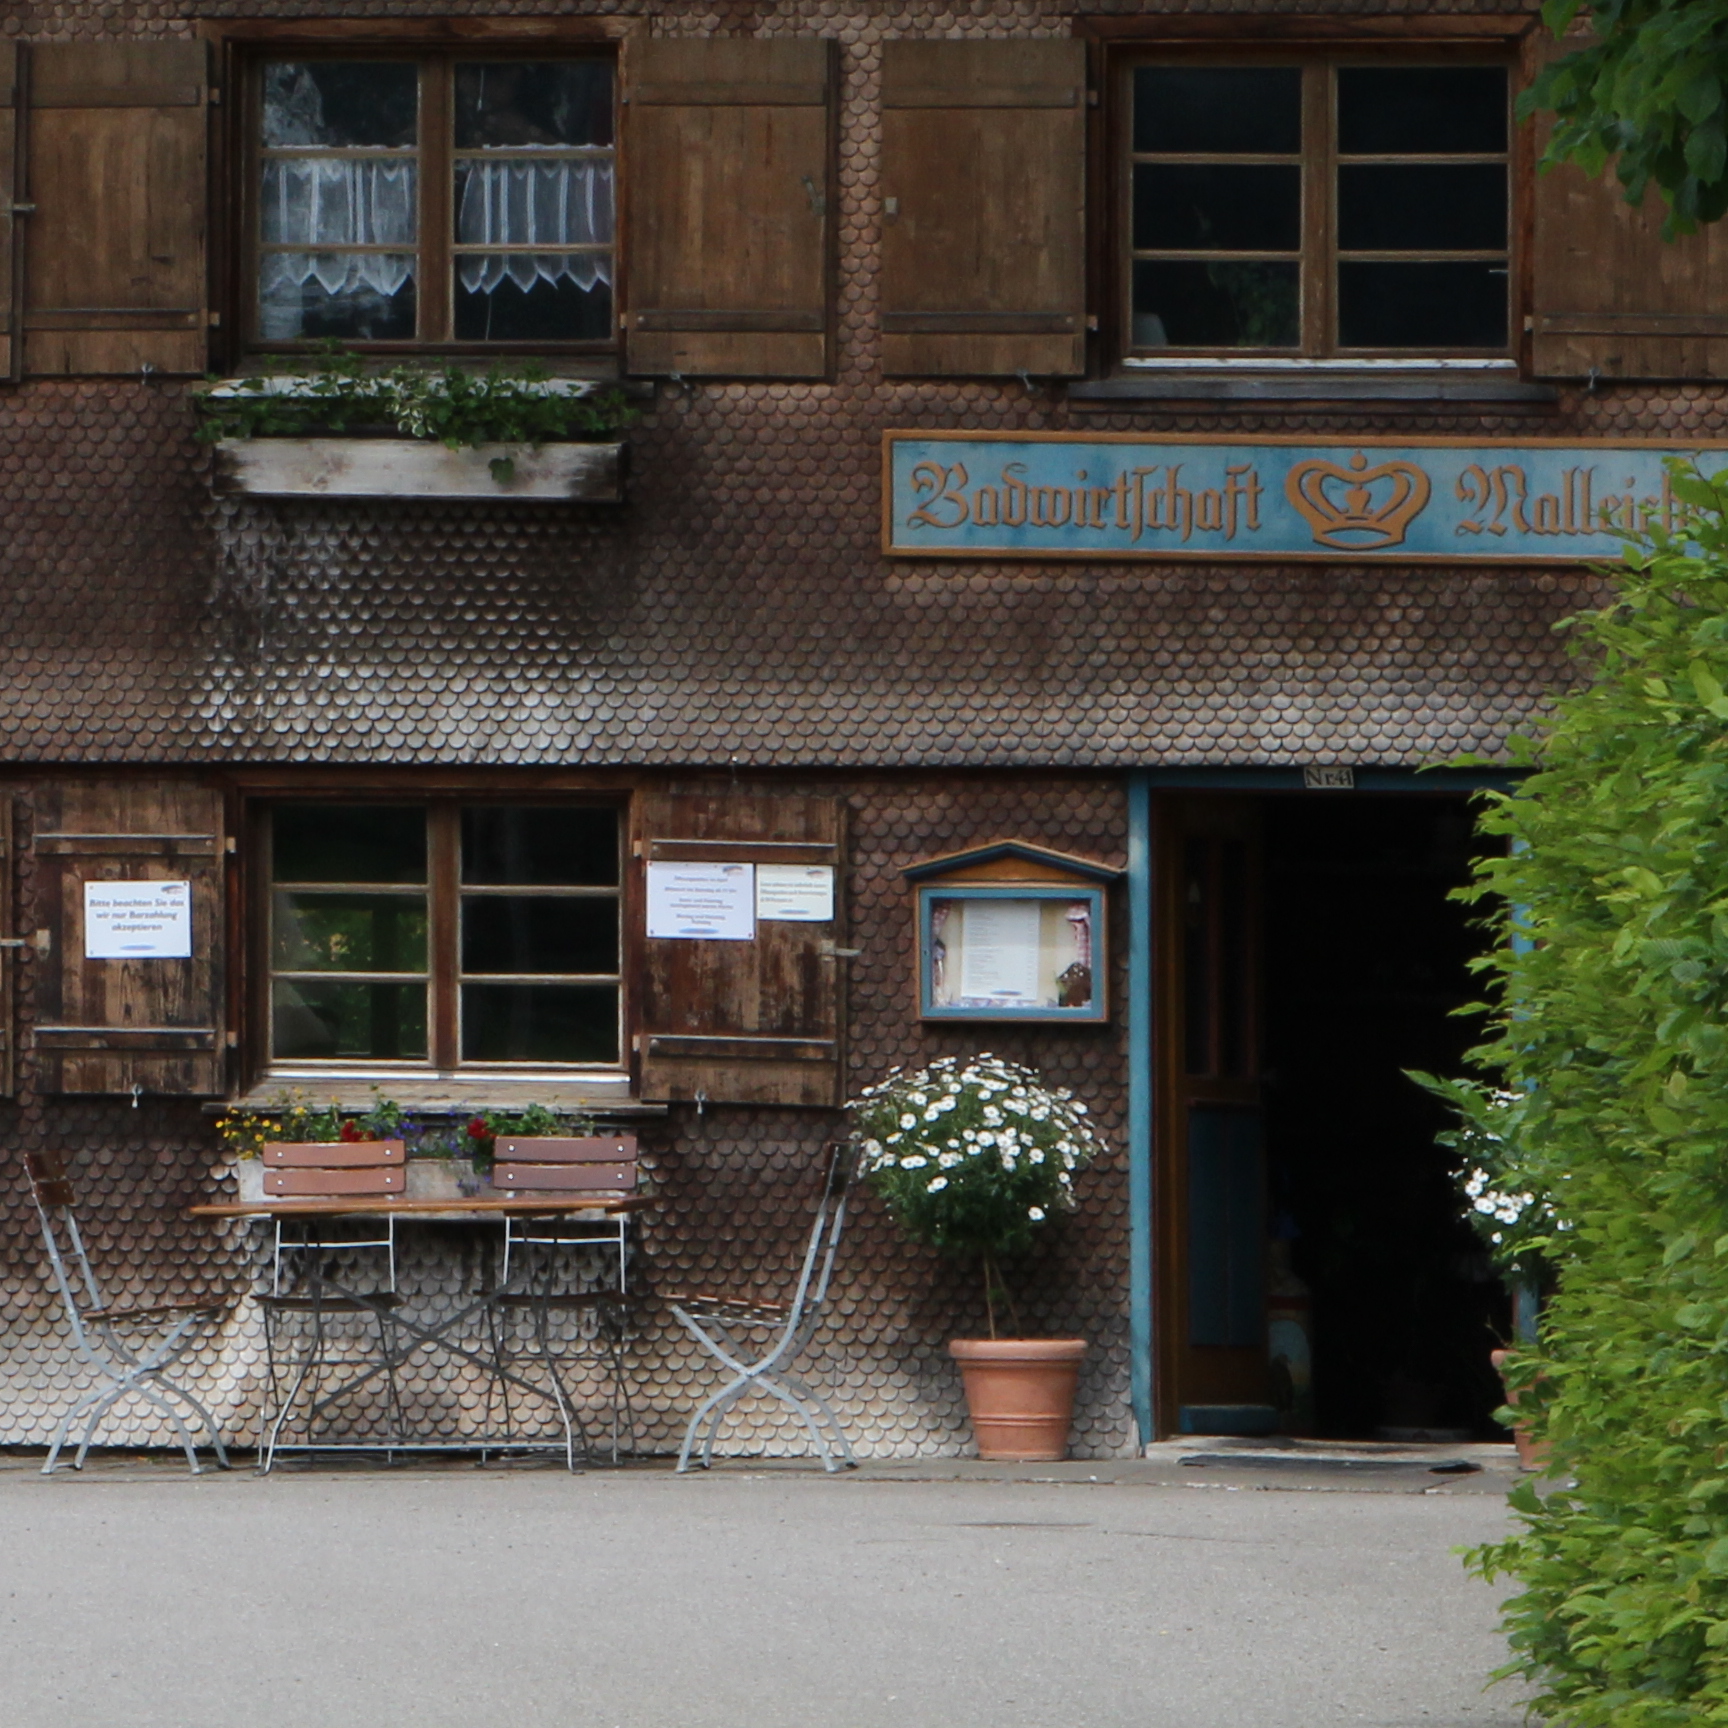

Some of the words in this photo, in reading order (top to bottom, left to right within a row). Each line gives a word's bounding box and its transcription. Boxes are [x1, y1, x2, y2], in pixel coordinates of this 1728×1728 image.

[905, 460, 1265, 544] Badwirtschaft
[89, 898, 110, 908] Bitte
[112, 898, 153, 908] beachten
[155, 898, 168, 908] Sie
